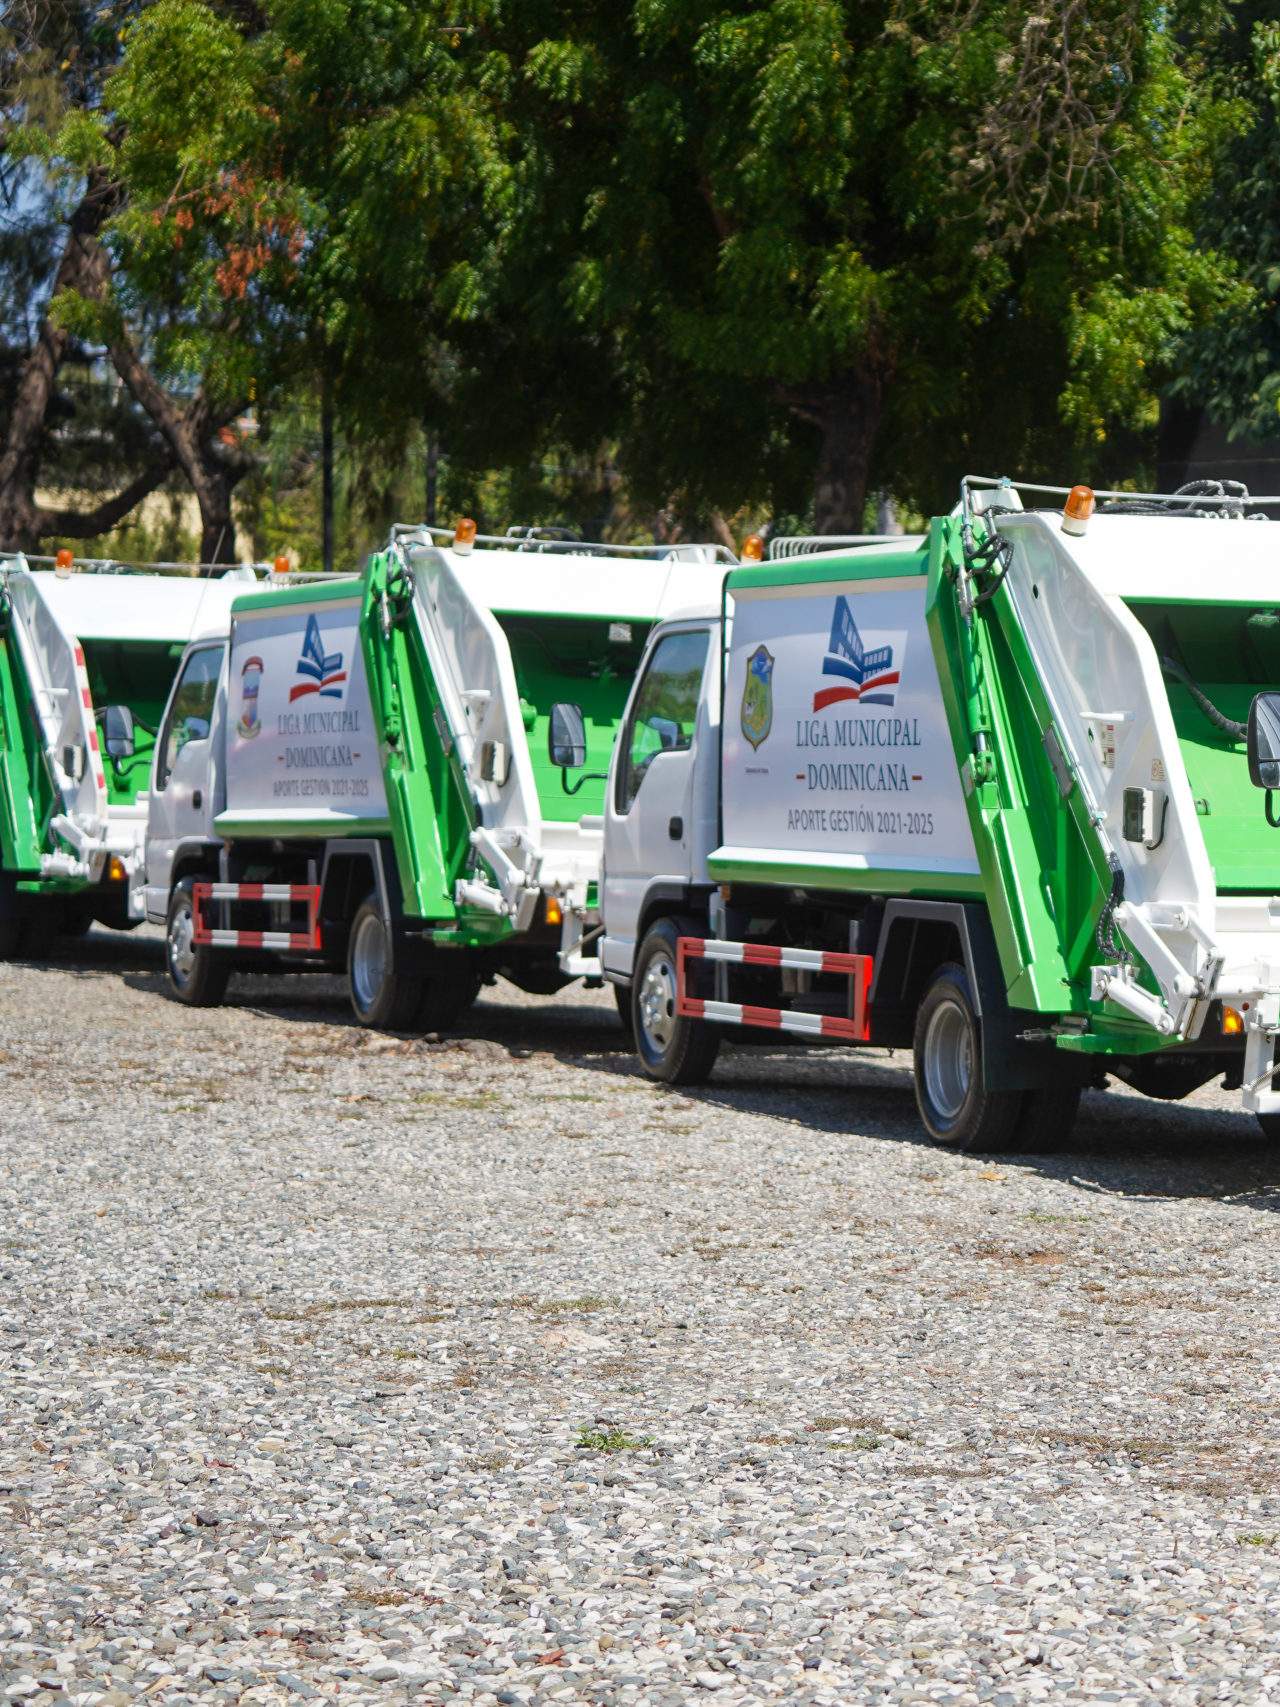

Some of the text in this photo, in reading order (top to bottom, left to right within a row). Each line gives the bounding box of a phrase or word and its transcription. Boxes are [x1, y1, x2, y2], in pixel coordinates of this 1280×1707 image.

[278, 710, 361, 735] LIGA MUNICIPAL
[796, 718, 921, 747] LIGA MUNICIPAL
[285, 745, 353, 768] DOMINICANA
[807, 764, 910, 791] DOMINICANA
[787, 804, 934, 835] APORTE GESTIÓN 2021-2025
